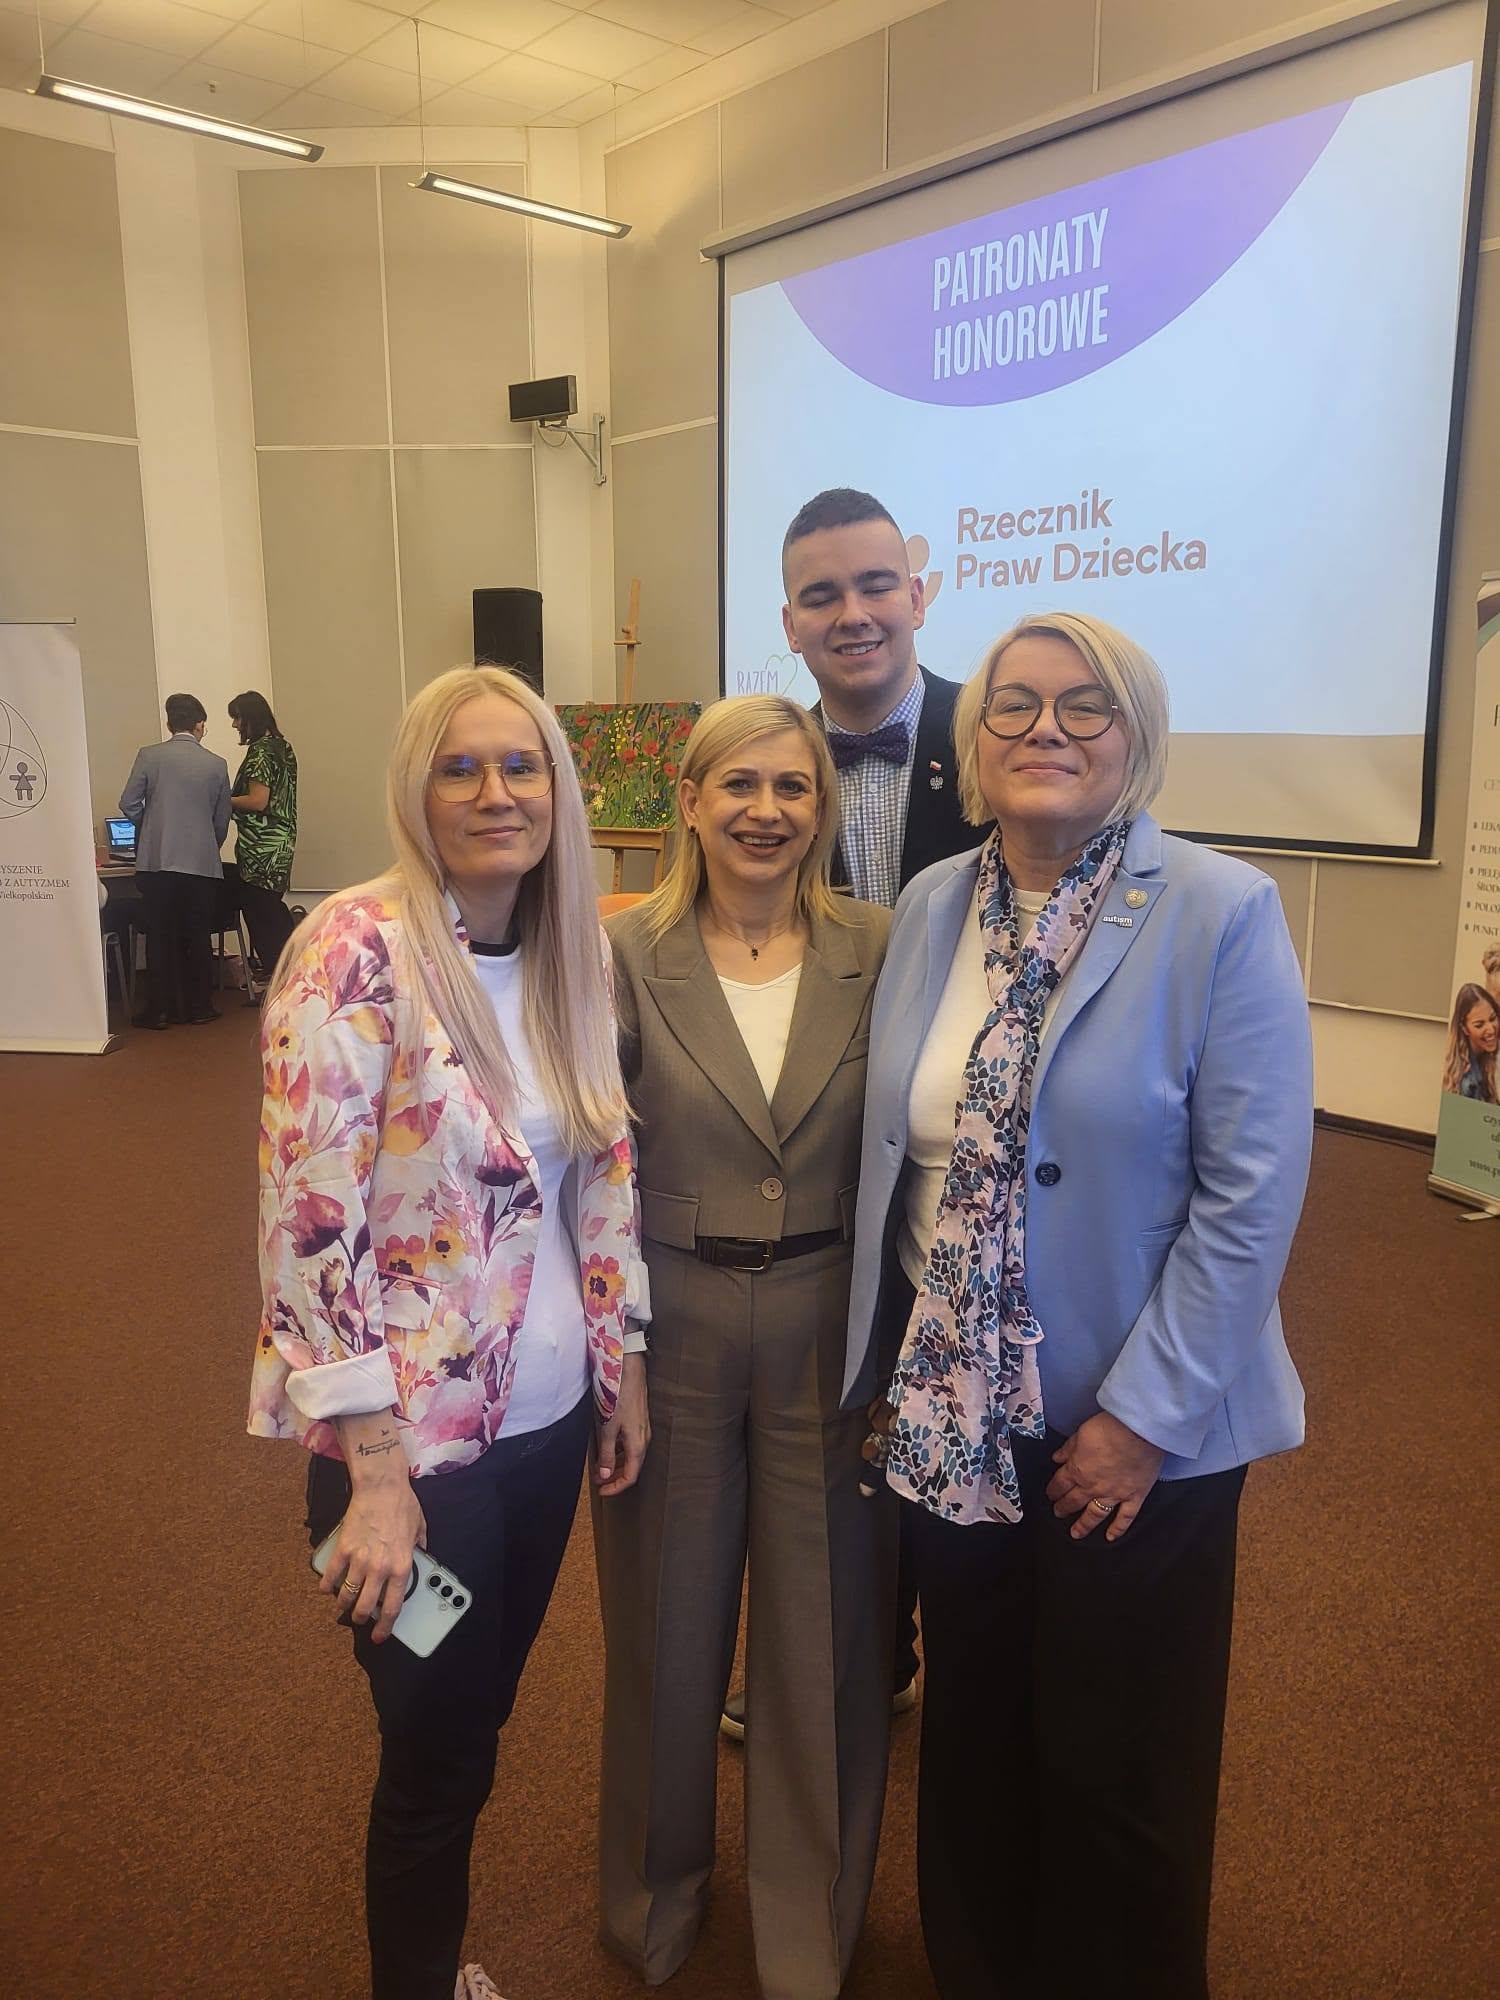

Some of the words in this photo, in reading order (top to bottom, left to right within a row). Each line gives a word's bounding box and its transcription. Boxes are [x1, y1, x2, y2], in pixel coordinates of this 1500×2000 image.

[933, 207, 1109, 312] PATRONATY
[933, 284, 1109, 381] HONOROWE
[957, 488, 1114, 545] Rzecznik
[956, 553, 1043, 590] Praw
[1053, 530, 1206, 582] Dziecka
[736, 670, 779, 696] RAZEM
[0, 865, 43, 874] YSZENIE
[13, 878, 71, 888] AUTYZMEM
